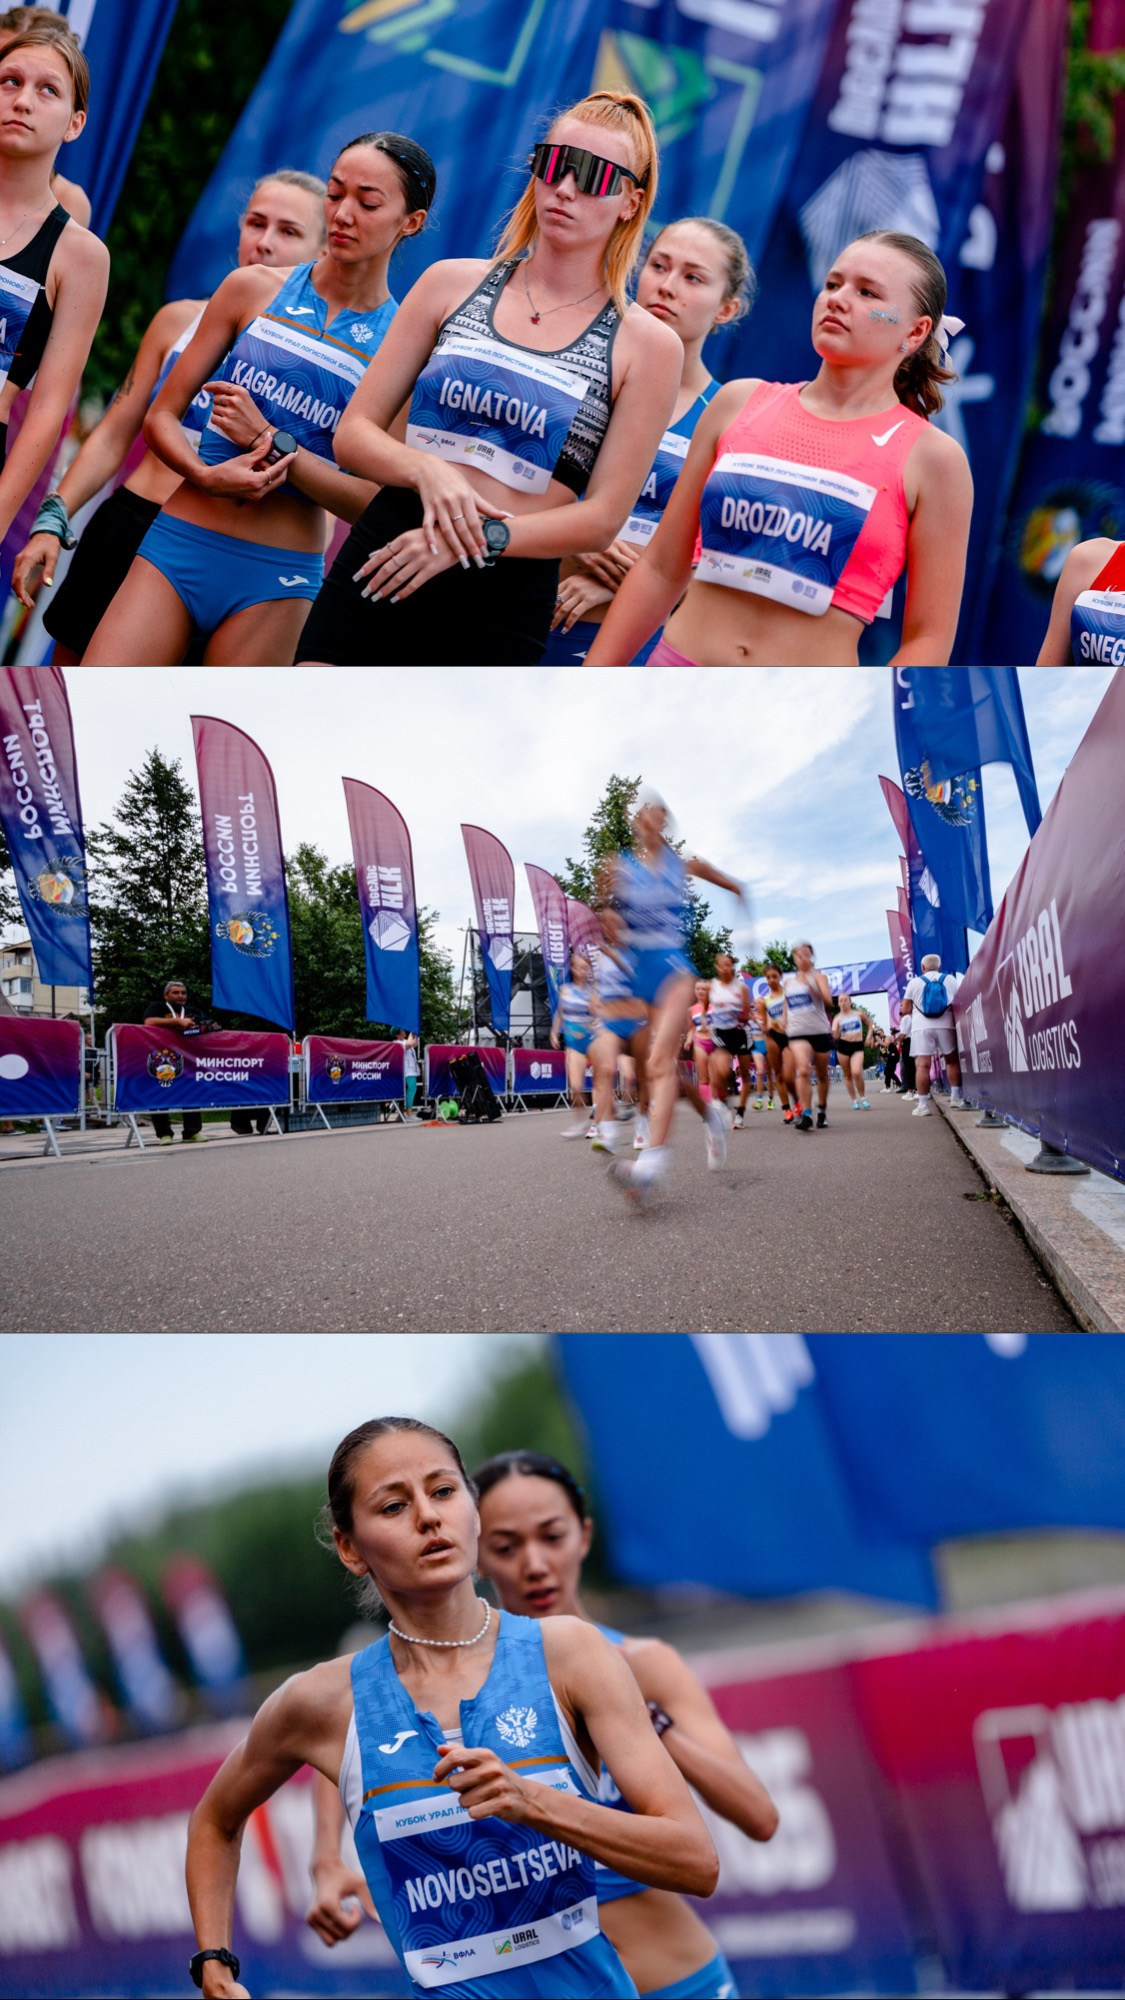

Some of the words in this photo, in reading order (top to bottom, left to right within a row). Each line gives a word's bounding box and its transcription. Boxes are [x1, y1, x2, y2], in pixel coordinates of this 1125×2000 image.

[264, 328, 284, 340] КУБОК
[285, 336, 301, 347] УРАЛ
[300, 345, 338, 366] ЛОГИСТИКИ
[474, 347, 492, 356] УРАЛ
[491, 351, 533, 371] ЛОГИСТИКИ
[534, 368, 573, 388] ВОРОНОВО
[439, 377, 548, 439] IGNATOVA
[476, 443, 495, 458] URAL
[756, 464, 774, 473] УРАЛ
[775, 468, 819, 482] ЛОГИСТИКИ
[818, 478, 860, 498] ВОРОНОВО
[721, 496, 833, 557] DROZDOVA
[1016, 897, 1073, 1019] URAL
[1028, 1019, 1082, 1071] LOGISTICS
[196, 1057, 264, 1069] МИНСПОРТ
[351, 1061, 390, 1071] МИНСПОРТ
[195, 1071, 249, 1082] РОССИИ
[351, 1071, 382, 1081] РОССИИ
[395, 1813, 427, 1828] КУБОК
[429, 1807, 455, 1820] УРАЛ
[405, 1841, 582, 1914] NOVOSELTSEVA
[512, 1928, 539, 1945] URAL
[514, 1939, 540, 1951] LOGISTICS
[453, 1948, 476, 1960] ВФЛА
